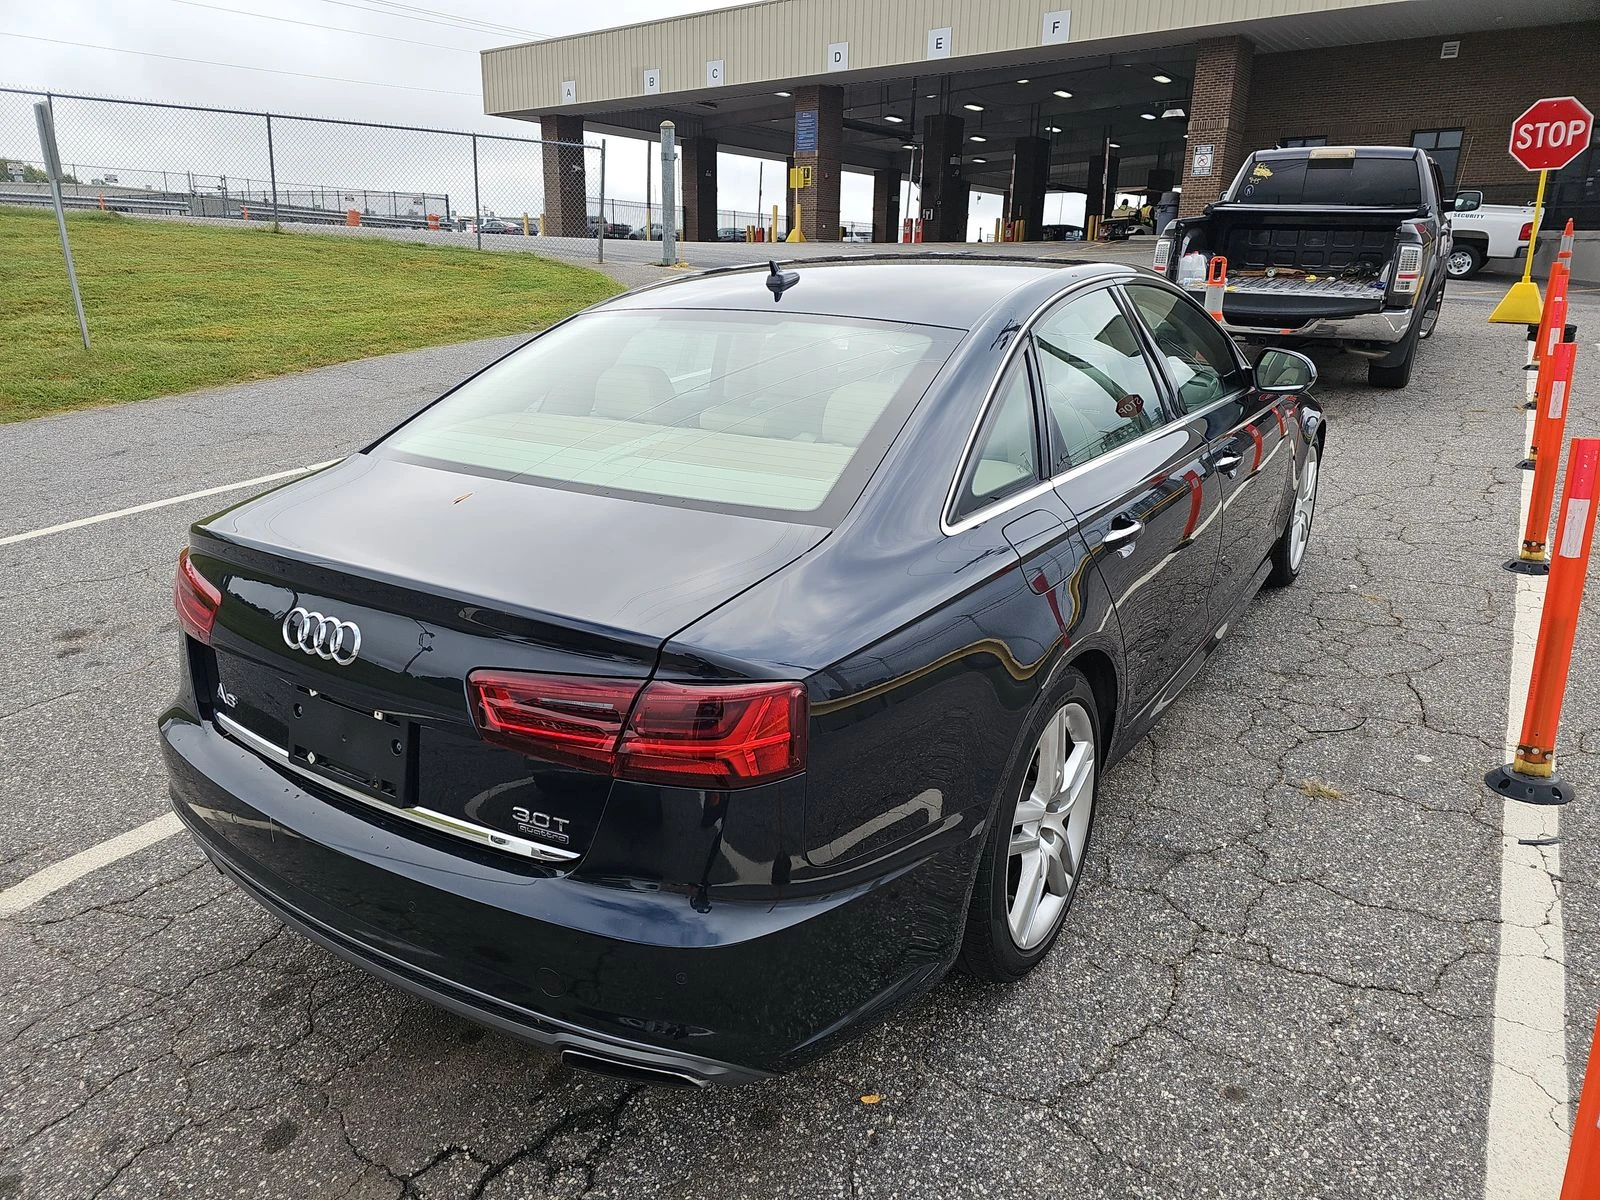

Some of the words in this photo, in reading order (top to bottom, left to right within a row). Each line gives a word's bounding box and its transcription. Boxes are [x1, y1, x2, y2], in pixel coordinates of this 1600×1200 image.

[1052, 21, 1060, 33] F
[936, 38, 943, 49] E
[834, 51, 842, 62] D
[711, 68, 719, 79] C
[649, 77, 655, 87] B
[566, 88, 572, 97] A
[1515, 119, 1586, 150] STOP
[512, 806, 570, 832] 3.0T
[519, 825, 567, 843] quattro
